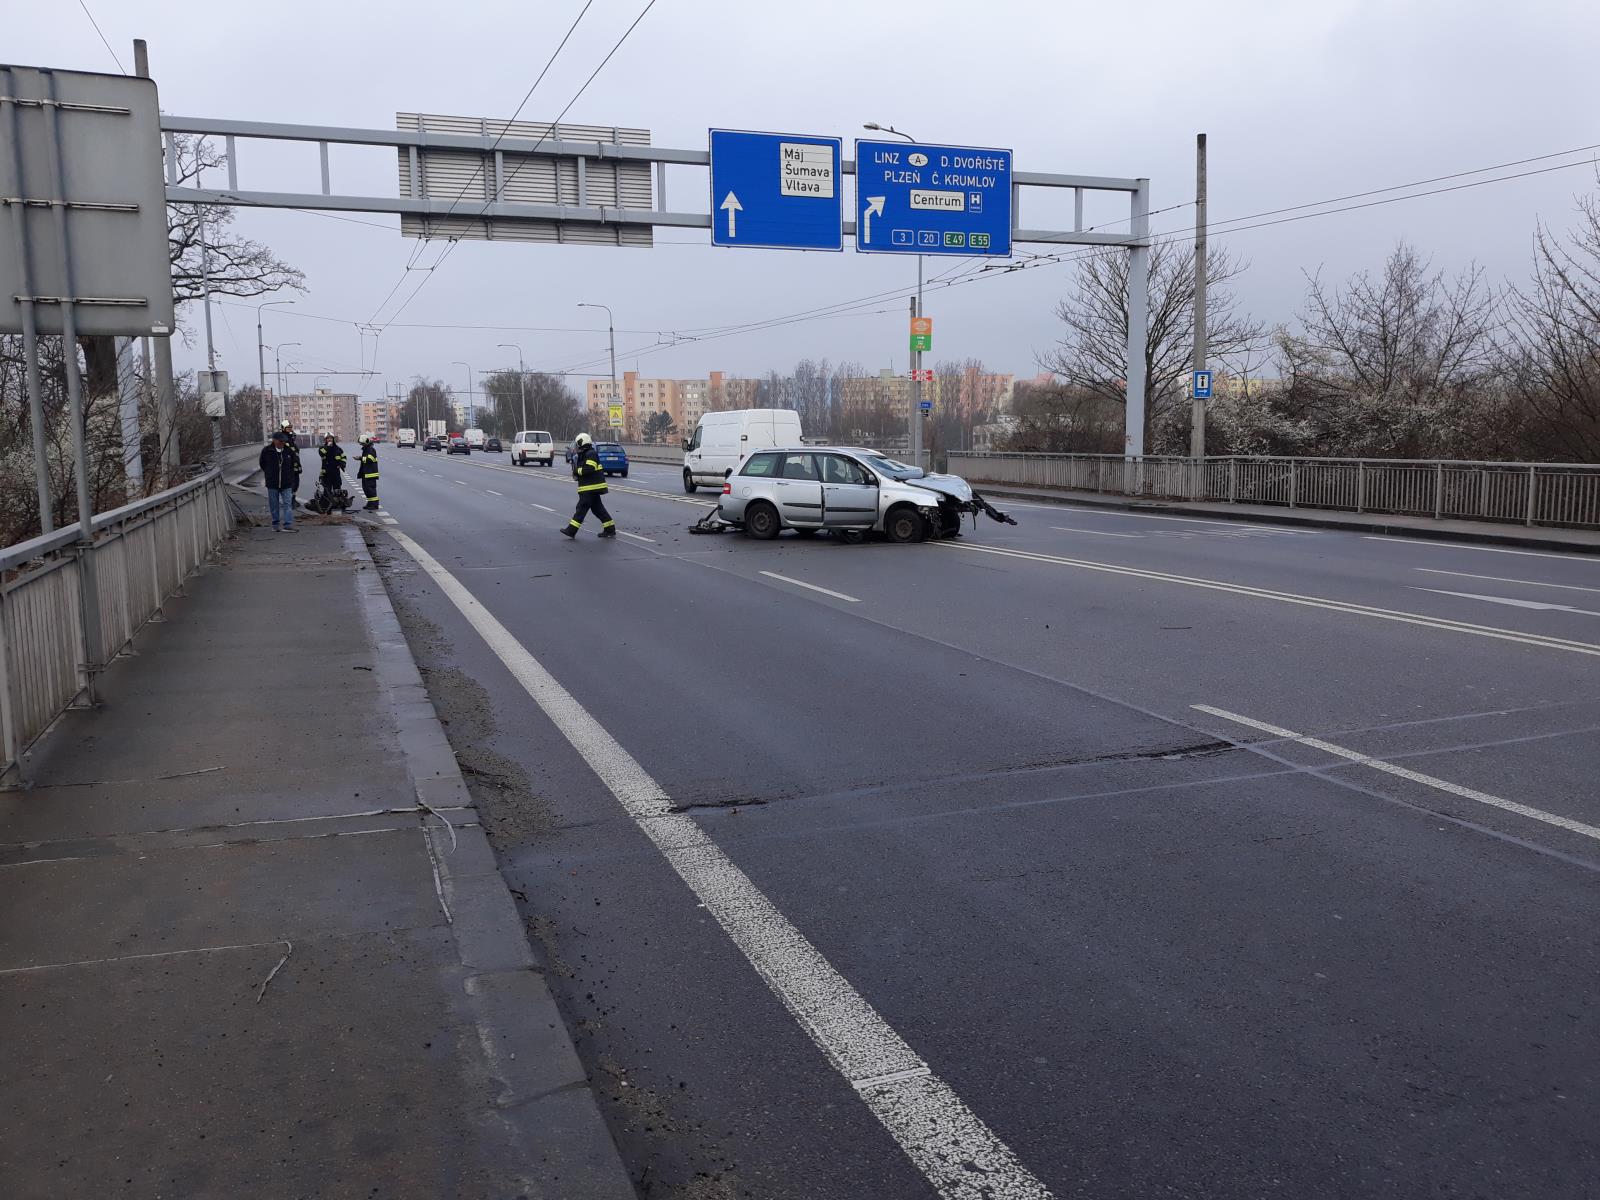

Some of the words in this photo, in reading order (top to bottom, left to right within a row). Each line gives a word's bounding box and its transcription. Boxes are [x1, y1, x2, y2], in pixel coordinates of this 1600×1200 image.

[784, 148, 804, 163] Máj
[874, 151, 900, 164] LINZ
[914, 155, 922, 164] A
[941, 156, 950, 167] D.
[954, 156, 1005, 171] DVOŘIŠTĚ
[785, 161, 829, 177] Šumava
[785, 179, 820, 192] Vltava
[885, 170, 920, 183] PLZEŇ
[932, 172, 941, 185] Č.
[944, 174, 996, 187] KRUMLOV
[913, 194, 961, 206] Centrum
[900, 232, 906, 242] 3
[923, 233, 934, 243] 20
[945, 234, 951, 244] E
[953, 235, 963, 244] 49
[971, 235, 977, 245] E
[978, 235, 988, 245] 55
